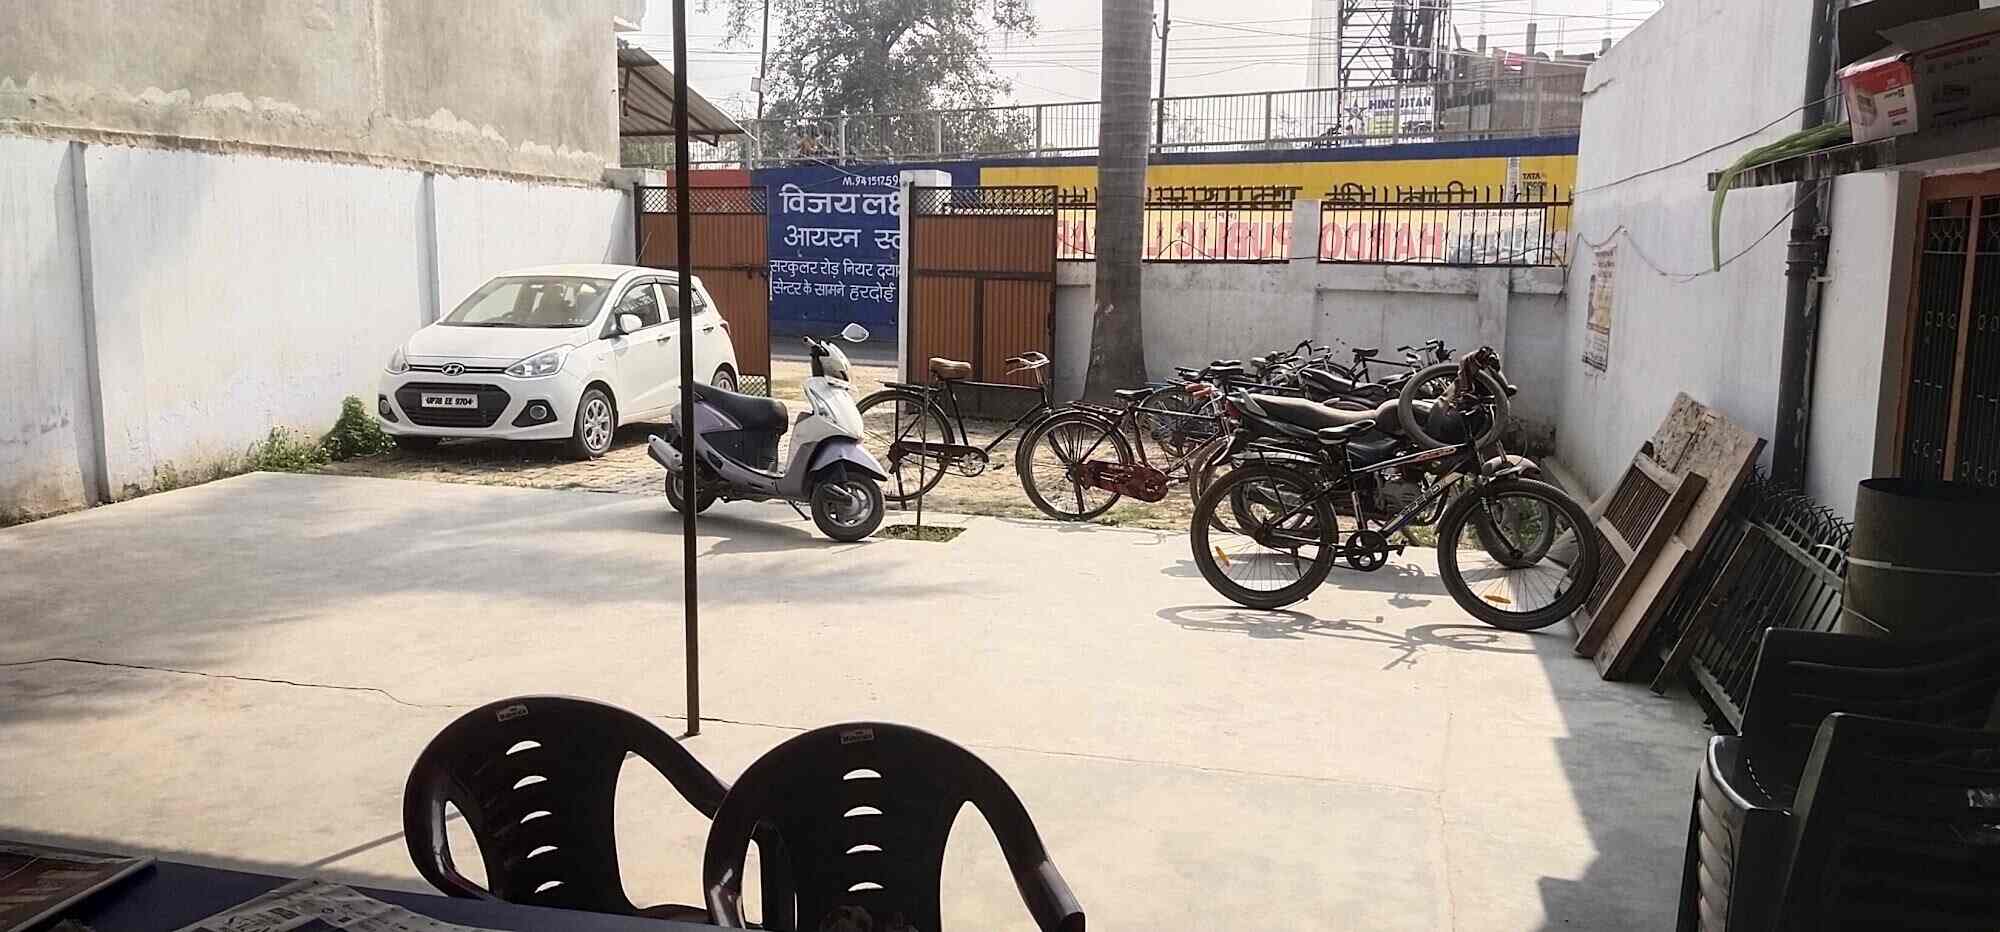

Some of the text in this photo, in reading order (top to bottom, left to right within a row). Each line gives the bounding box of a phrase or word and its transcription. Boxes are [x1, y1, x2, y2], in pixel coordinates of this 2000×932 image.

[842, 175, 899, 186] M.94151759
[1522, 172, 1541, 180] TATA
[778, 183, 860, 214] विजय
[783, 224, 862, 248] आयरन
[770, 259, 818, 277] सरकुलर
[843, 258, 874, 277] नियर
[876, 263, 901, 280] दया
[803, 279, 812, 295] के
[814, 280, 846, 297] सामने
[849, 282, 896, 303] हरदोई
